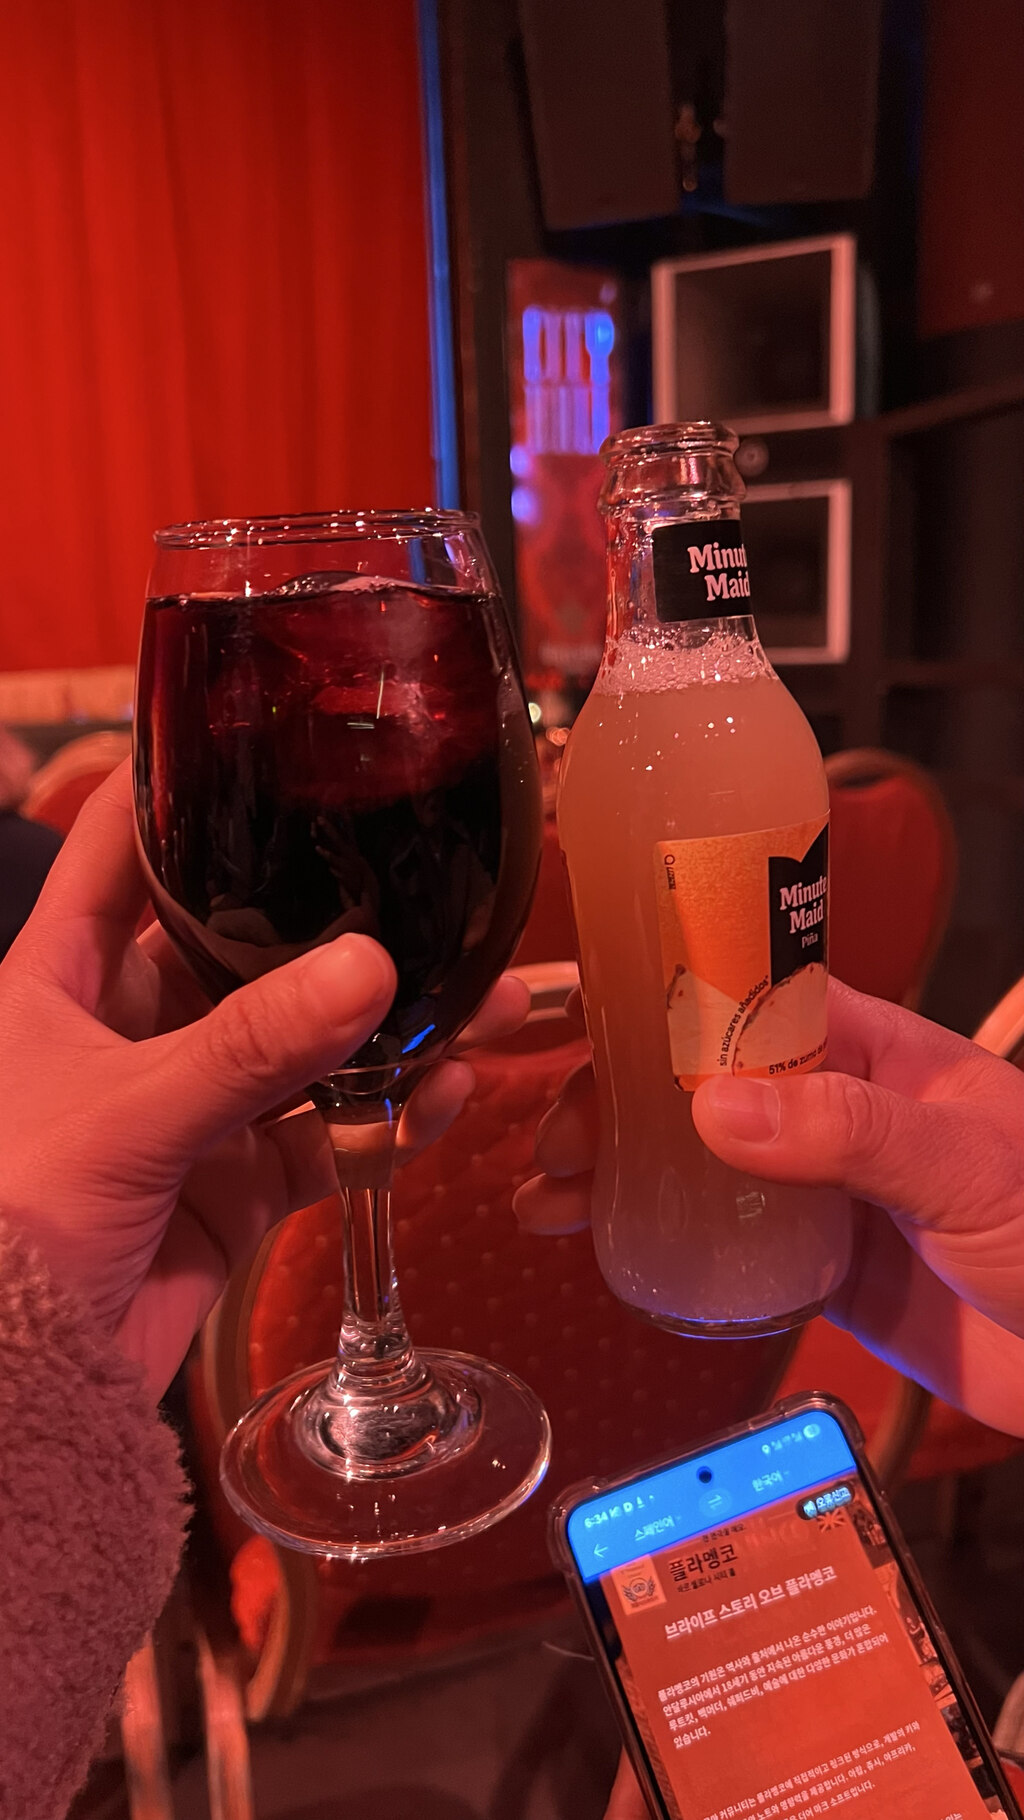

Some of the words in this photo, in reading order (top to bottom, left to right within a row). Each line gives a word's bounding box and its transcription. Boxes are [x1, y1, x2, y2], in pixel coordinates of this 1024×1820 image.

[687, 542, 747, 573] Minut
[704, 570, 750, 601] Maid
[789, 898, 824, 934] Maid
[801, 932, 818, 949] Piña
[721, 1014, 741, 1052] azúcares
[717, 1054, 727, 1066] sin
[769, 1062, 786, 1075] 51%
[788, 1059, 798, 1069] de
[752, 1471, 783, 1491] 한국어
[816, 1487, 850, 1509] 오류신고
[584, 1512, 608, 1528] 6:34
[635, 1516, 674, 1541] 스페인어
[670, 1544, 738, 1581] 플라멩코
[665, 1609, 717, 1639] 브라이프
[719, 1593, 758, 1619] 스토리
[759, 1584, 785, 1604] 오브
[785, 1566, 836, 1596] 플라멩코
[658, 1676, 700, 1701] 플라멩코의
[700, 1666, 725, 1683] 기원은
[725, 1655, 751, 1672] 역사와
[752, 1642, 784, 1663] 출처에서
[784, 1635, 801, 1648] 나온
[802, 1625, 826, 1642] 순수한
[826, 1605, 876, 1630] 이야기입니다.
[663, 1685, 721, 1716] 안달루시아에서
[721, 1673, 749, 1692] 18세기
[749, 1666, 766, 1681] 동안
[766, 1656, 792, 1672] 지속된
[792, 1643, 824, 1662] 아름다운
[824, 1635, 845, 1650] 풍경,
[844, 1630, 854, 1640] 더
[853, 1624, 870, 1638] 많은
[669, 1712, 698, 1731] 루트킷,
[763, 1673, 789, 1691] 예술에
[788, 1667, 806, 1680] 대한
[806, 1656, 831, 1673] 다양한
[831, 1646, 856, 1664] 문화가
[856, 1632, 888, 1653] 혼합되어
[673, 1726, 710, 1748] 있습니다.
[719, 1798, 756, 1819] 커뮤니티는
[793, 1763, 829, 1784] 직접적이고
[852, 1739, 884, 1759] 방식으로,
[883, 1728, 905, 1743] 개발의
[905, 1721, 920, 1733] 키와
[757, 1804, 779, 1820] 노트와
[780, 1790, 809, 1810] 영향력을
[809, 1773, 848, 1795] 제공합니다.
[883, 1743, 915, 1761] 아프리카,
[830, 1780, 875, 1806] 소프트입니다.
